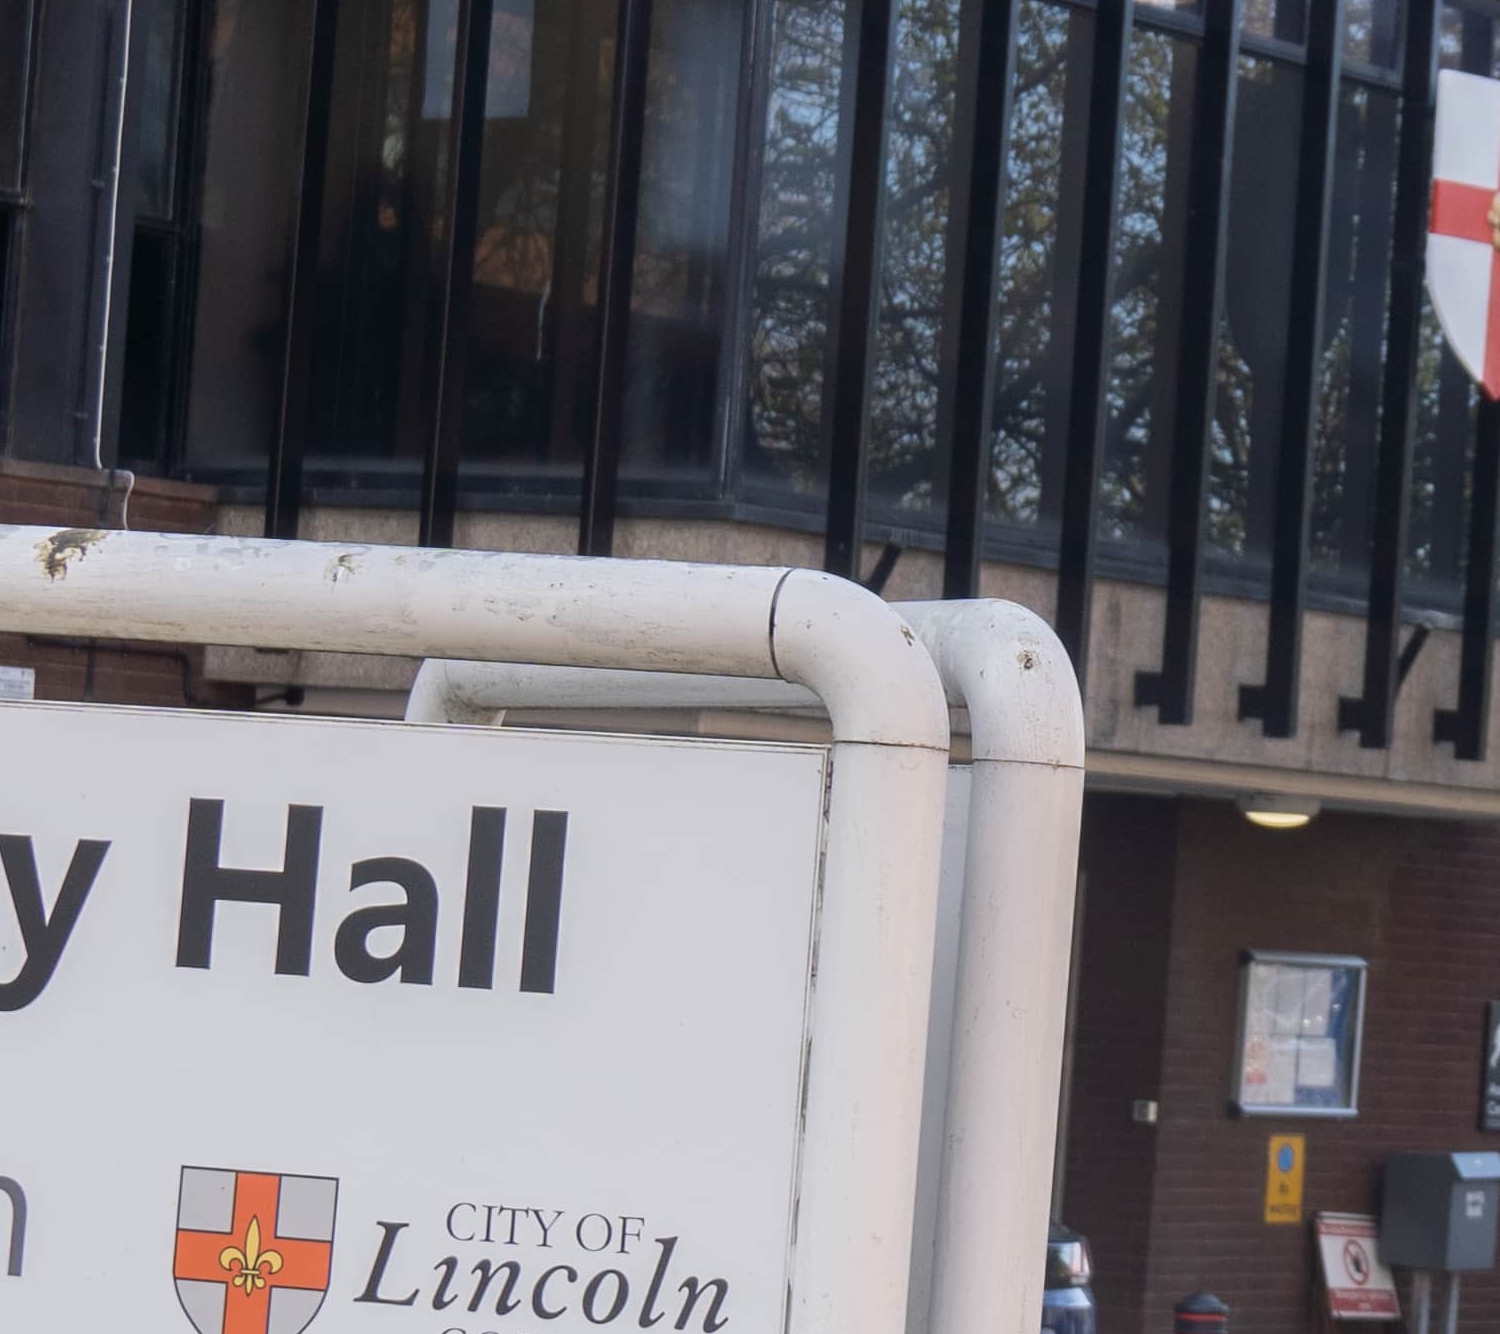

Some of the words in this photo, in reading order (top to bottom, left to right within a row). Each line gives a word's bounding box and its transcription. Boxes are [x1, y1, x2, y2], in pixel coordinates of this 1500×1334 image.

[176, 798, 568, 994] Hall
[354, 1221, 729, 1334] Lincoln
[446, 1203, 564, 1248] CITY
[576, 1214, 645, 1254] OF
